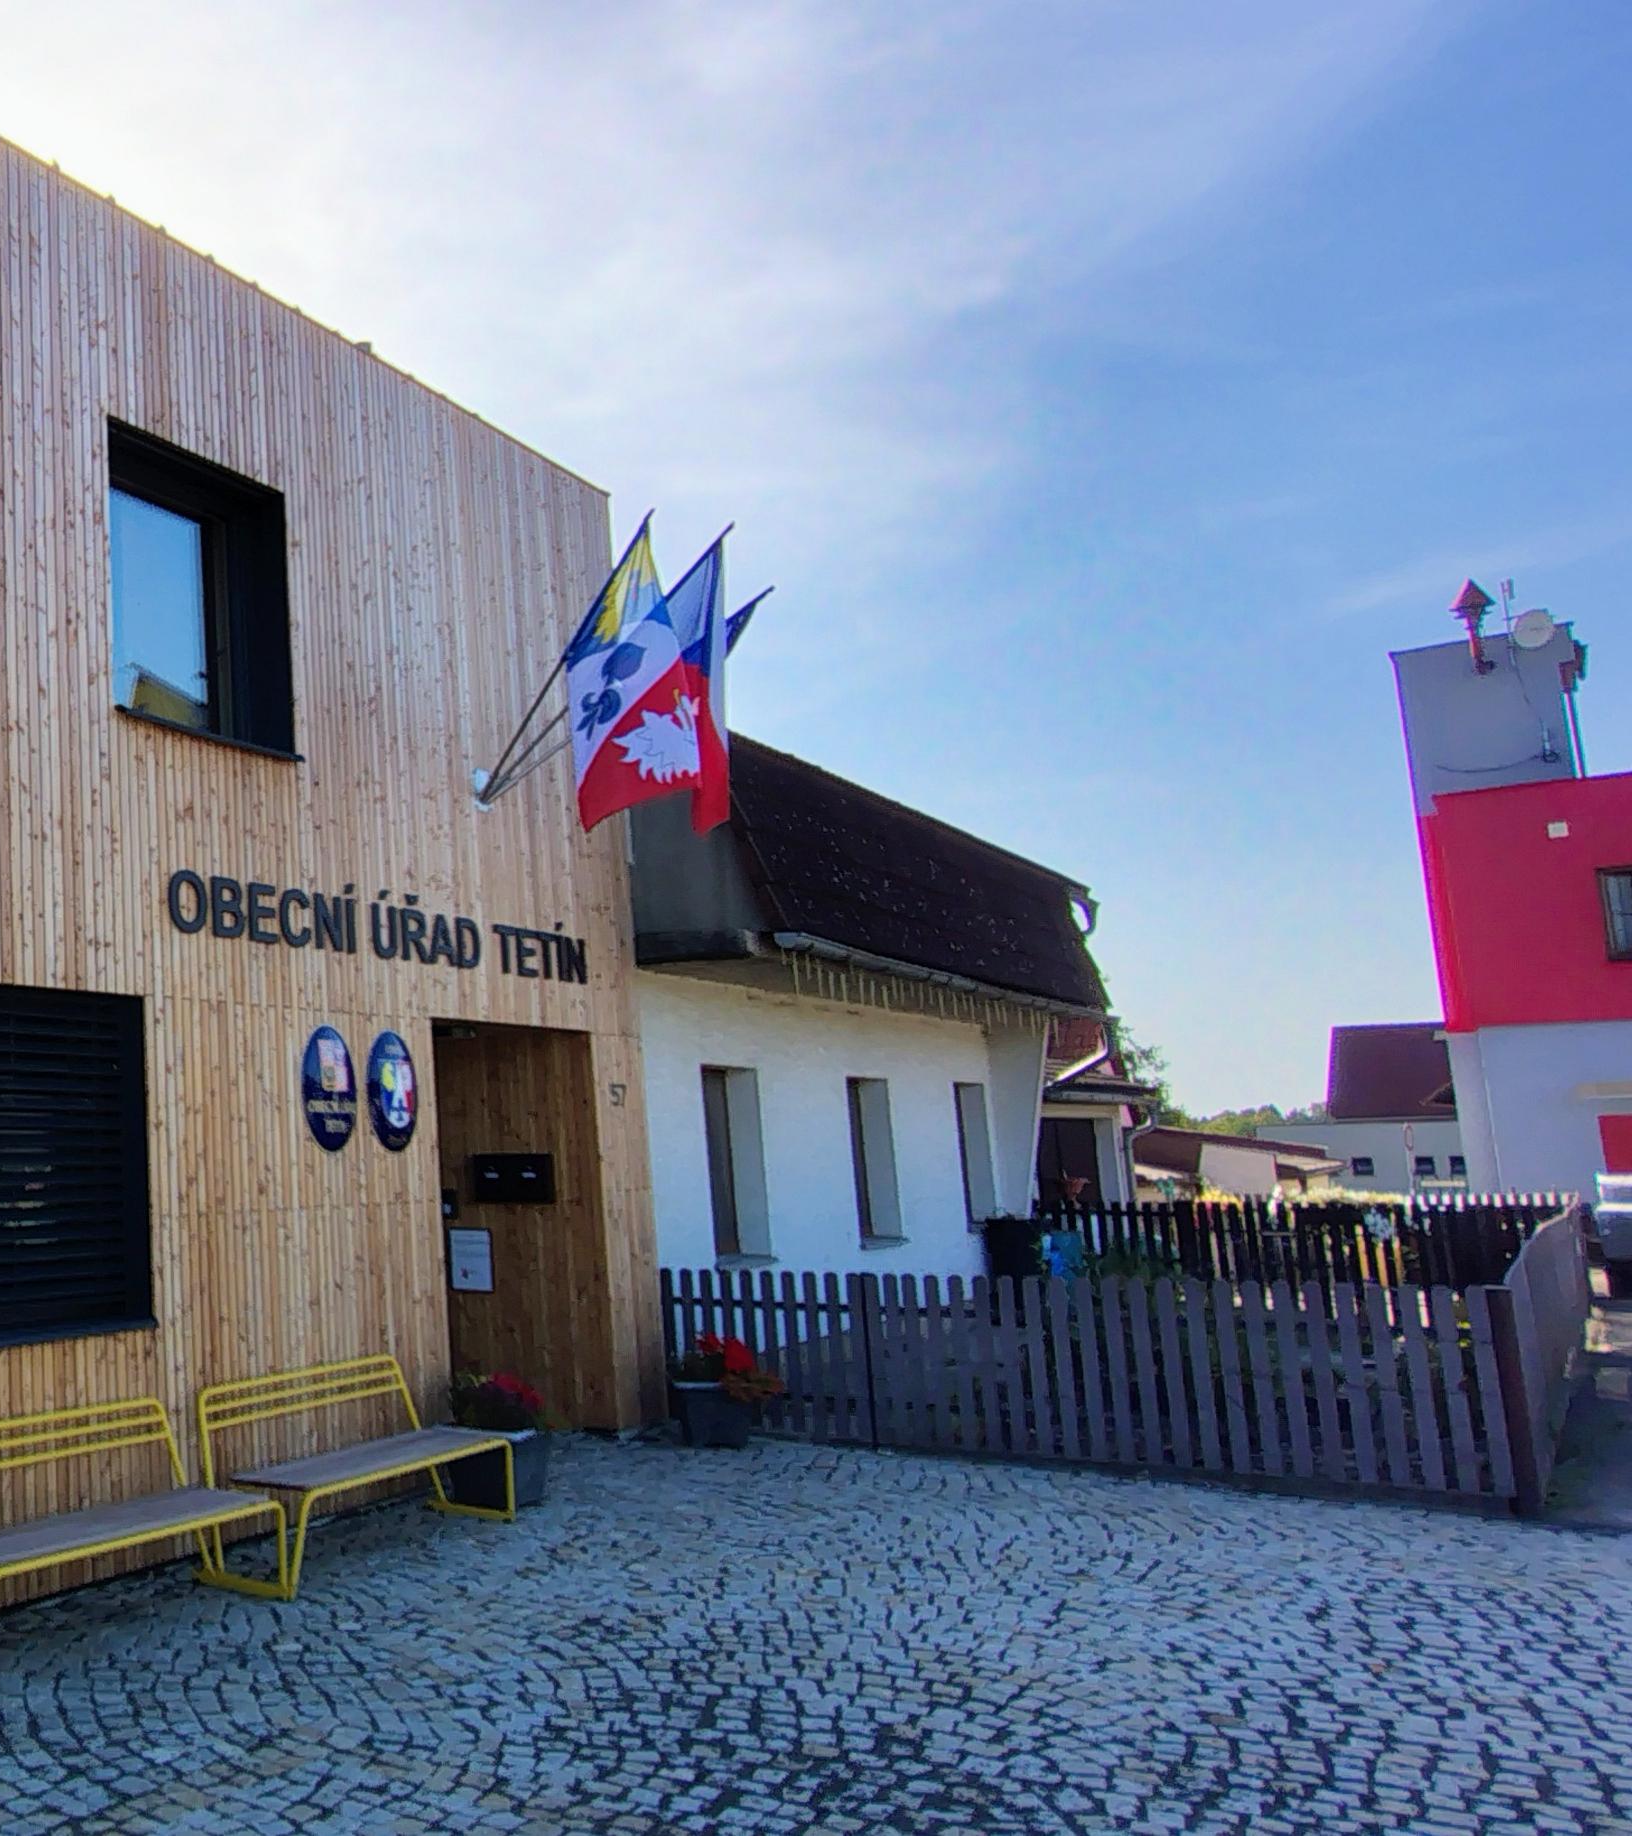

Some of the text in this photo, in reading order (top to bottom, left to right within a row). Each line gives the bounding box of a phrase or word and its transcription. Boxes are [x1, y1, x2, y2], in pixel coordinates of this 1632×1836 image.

[168, 869, 588, 985] OBECNÍ ÚŘAD TETÍN
[608, 1083, 627, 1107] 57
